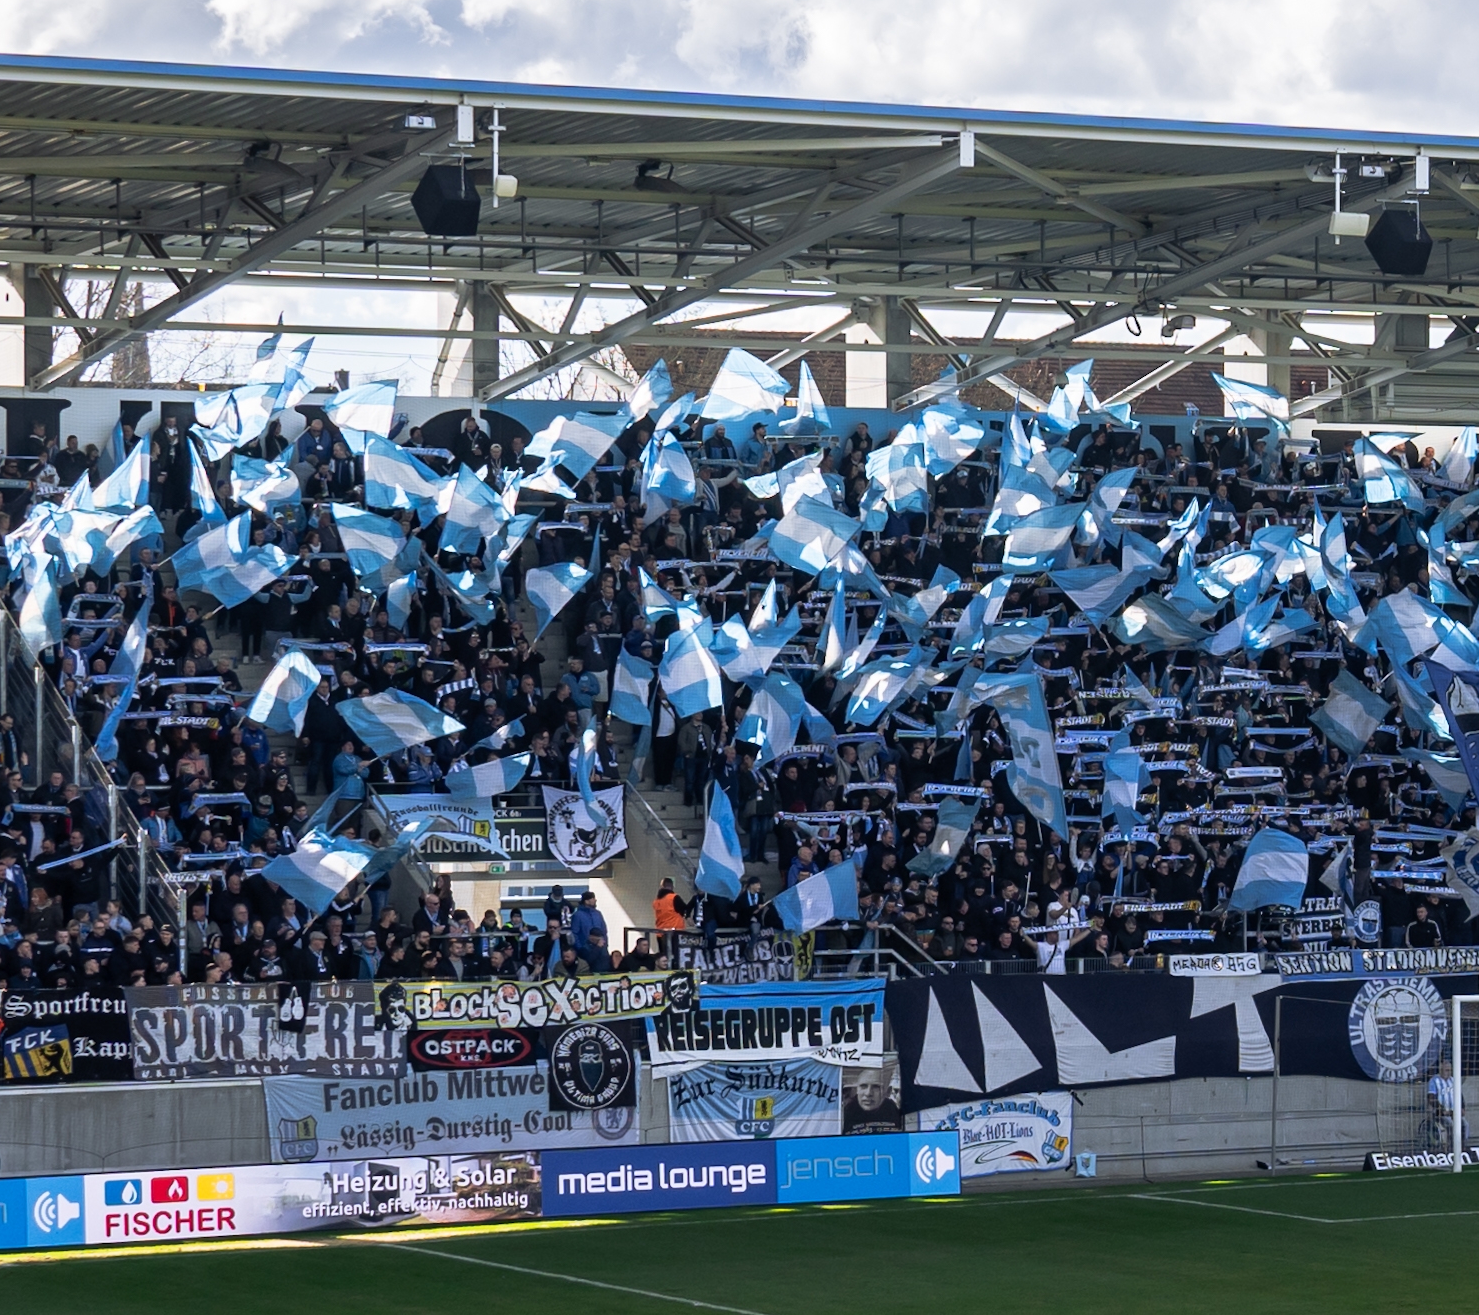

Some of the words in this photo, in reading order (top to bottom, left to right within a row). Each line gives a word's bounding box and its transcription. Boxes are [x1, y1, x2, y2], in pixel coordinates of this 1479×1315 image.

[1278, 952, 1352, 977] SEKTION
[4, 991, 127, 1020] Sportfreu
[135, 1007, 270, 1066] SPORT
[654, 1007, 824, 1053] REISEGRUPPE
[830, 1003, 875, 1044] OST
[4, 1028, 55, 1054] FCK
[425, 1037, 517, 1056] OSTPACK
[332, 1061, 401, 1076] STADT
[324, 1078, 438, 1114] Fanclub
[447, 1068, 549, 1101] Mittwe
[672, 1073, 716, 1113] Zur
[721, 1064, 840, 1105] Südkurve
[739, 1121, 771, 1134] CFC
[332, 1166, 427, 1196] Heizung
[433, 1167, 451, 1189] &
[456, 1163, 517, 1187] Solar
[557, 1164, 653, 1195] media
[658, 1159, 767, 1194] lounge
[781, 1148, 893, 1191] jensch
[301, 1198, 375, 1218] effizient,
[377, 1195, 445, 1215] effektiv,
[447, 1190, 529, 1213] nachhaltig
[105, 1207, 236, 1237] FISCHER
